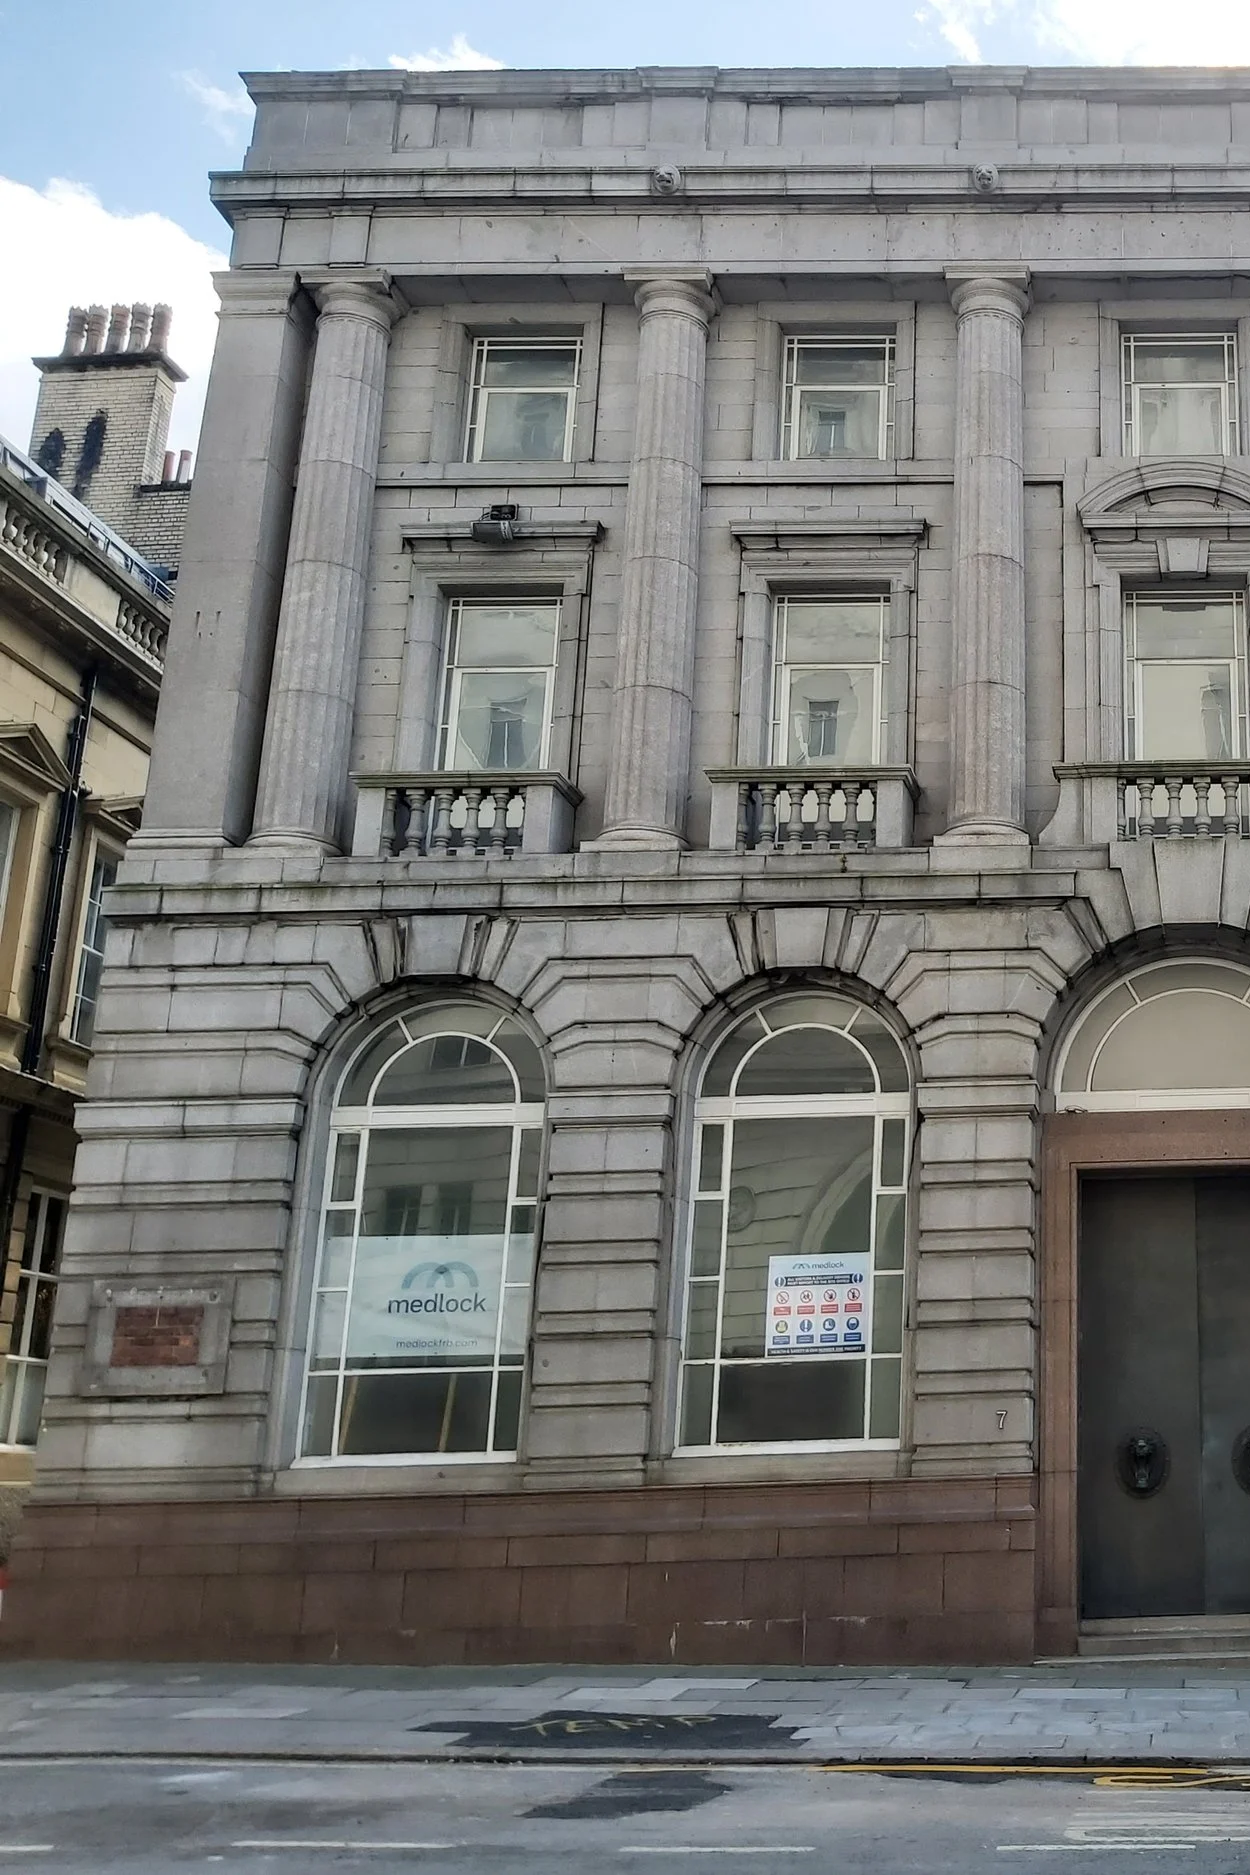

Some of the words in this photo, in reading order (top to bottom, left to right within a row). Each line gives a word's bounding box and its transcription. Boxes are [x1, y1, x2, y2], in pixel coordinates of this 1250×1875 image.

[811, 1260, 845, 1269] medlock
[387, 1291, 487, 1314] medlock
[995, 1410, 1008, 1430] 7
[510, 1713, 718, 1737] TEMP
